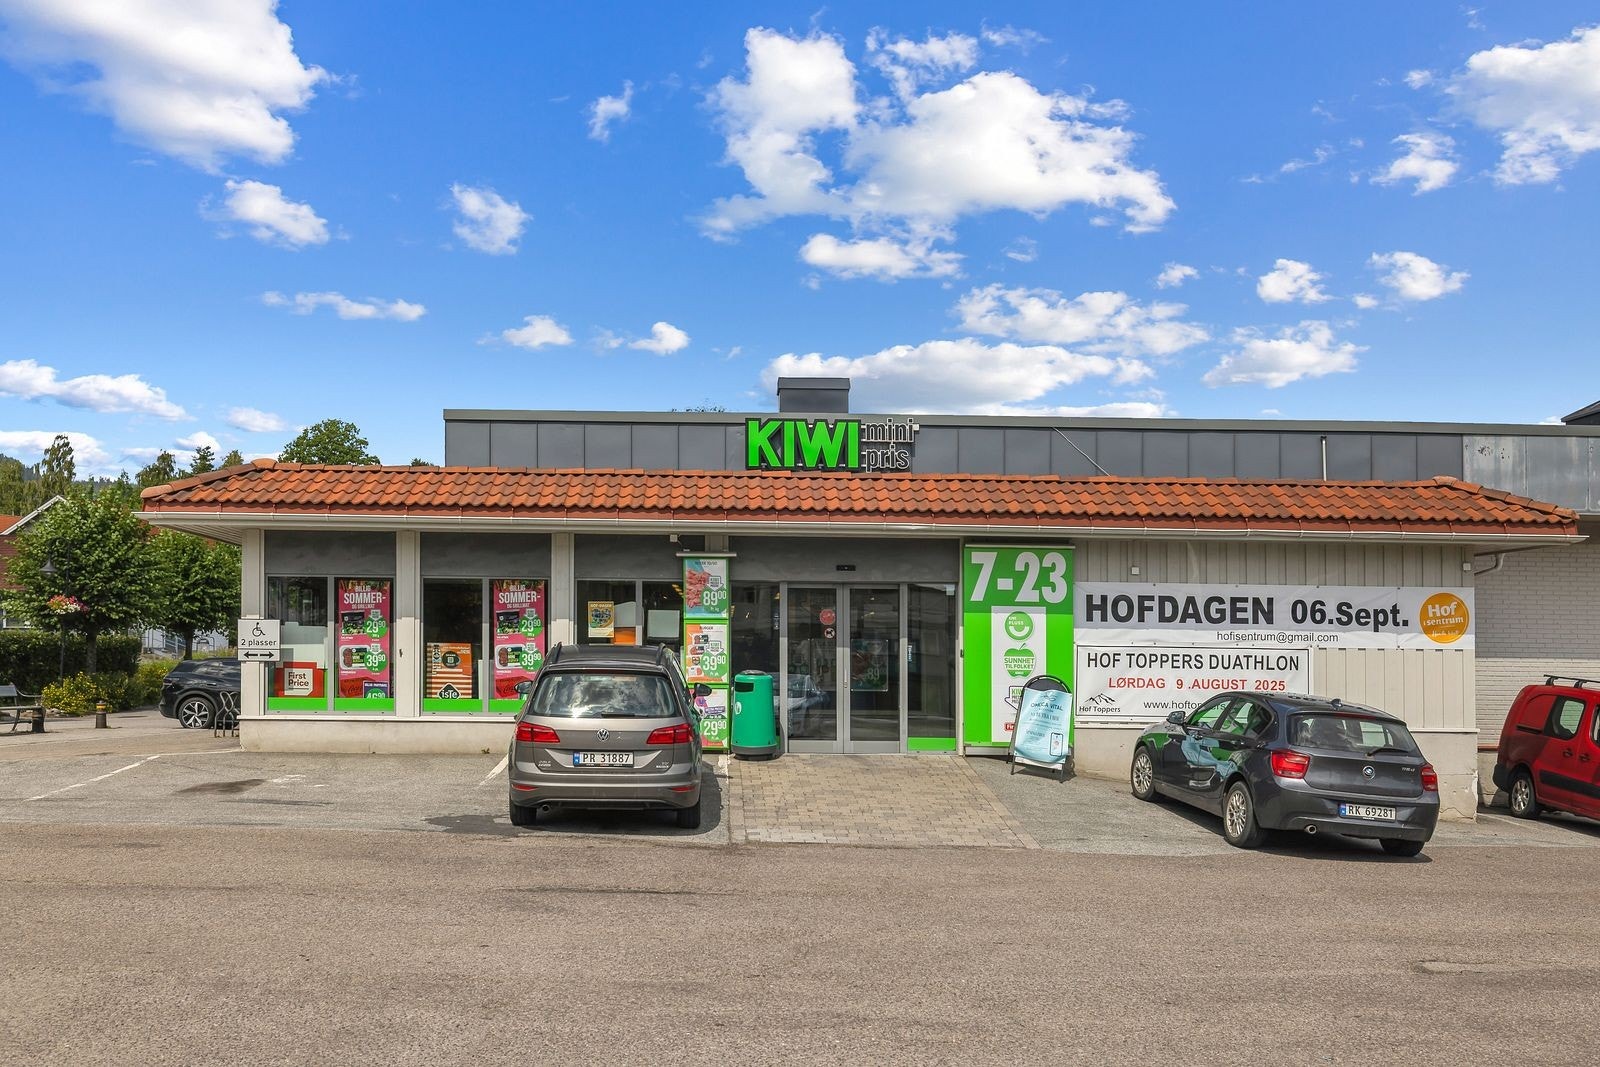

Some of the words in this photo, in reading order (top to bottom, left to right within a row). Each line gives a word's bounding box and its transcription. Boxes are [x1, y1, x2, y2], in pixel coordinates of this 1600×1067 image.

[866, 418, 914, 442] mini
[746, 419, 860, 469] KIWI
[866, 444, 909, 472] pris
[970, 552, 1068, 604] 7-23
[344, 592, 386, 604] SOMMER-
[499, 591, 541, 604] SOMMER-
[1086, 594, 1274, 625] HOFDAGEN
[1291, 599, 1409, 632] 06.Sept.
[1428, 602, 1458, 617] Hof
[1427, 616, 1464, 626] sentrum
[248, 638, 277, 648] plasser
[1217, 631, 1338, 643] hofisentrum@gmail.com
[1087, 652, 1121, 668] HOF
[1126, 653, 1204, 670] TOPPERS
[1209, 654, 1299, 671] DUATHLON
[288, 671, 306, 680] First
[1108, 677, 1166, 689] LØRDAG
[1255, 680, 1286, 691] 2025
[1012, 688, 1022, 696] KIW
[1093, 706, 1121, 714] Toppers
[583, 753, 595, 763] PR
[600, 753, 630, 763] 31887
[1348, 805, 1361, 816] RK
[1365, 807, 1394, 818] 69281
